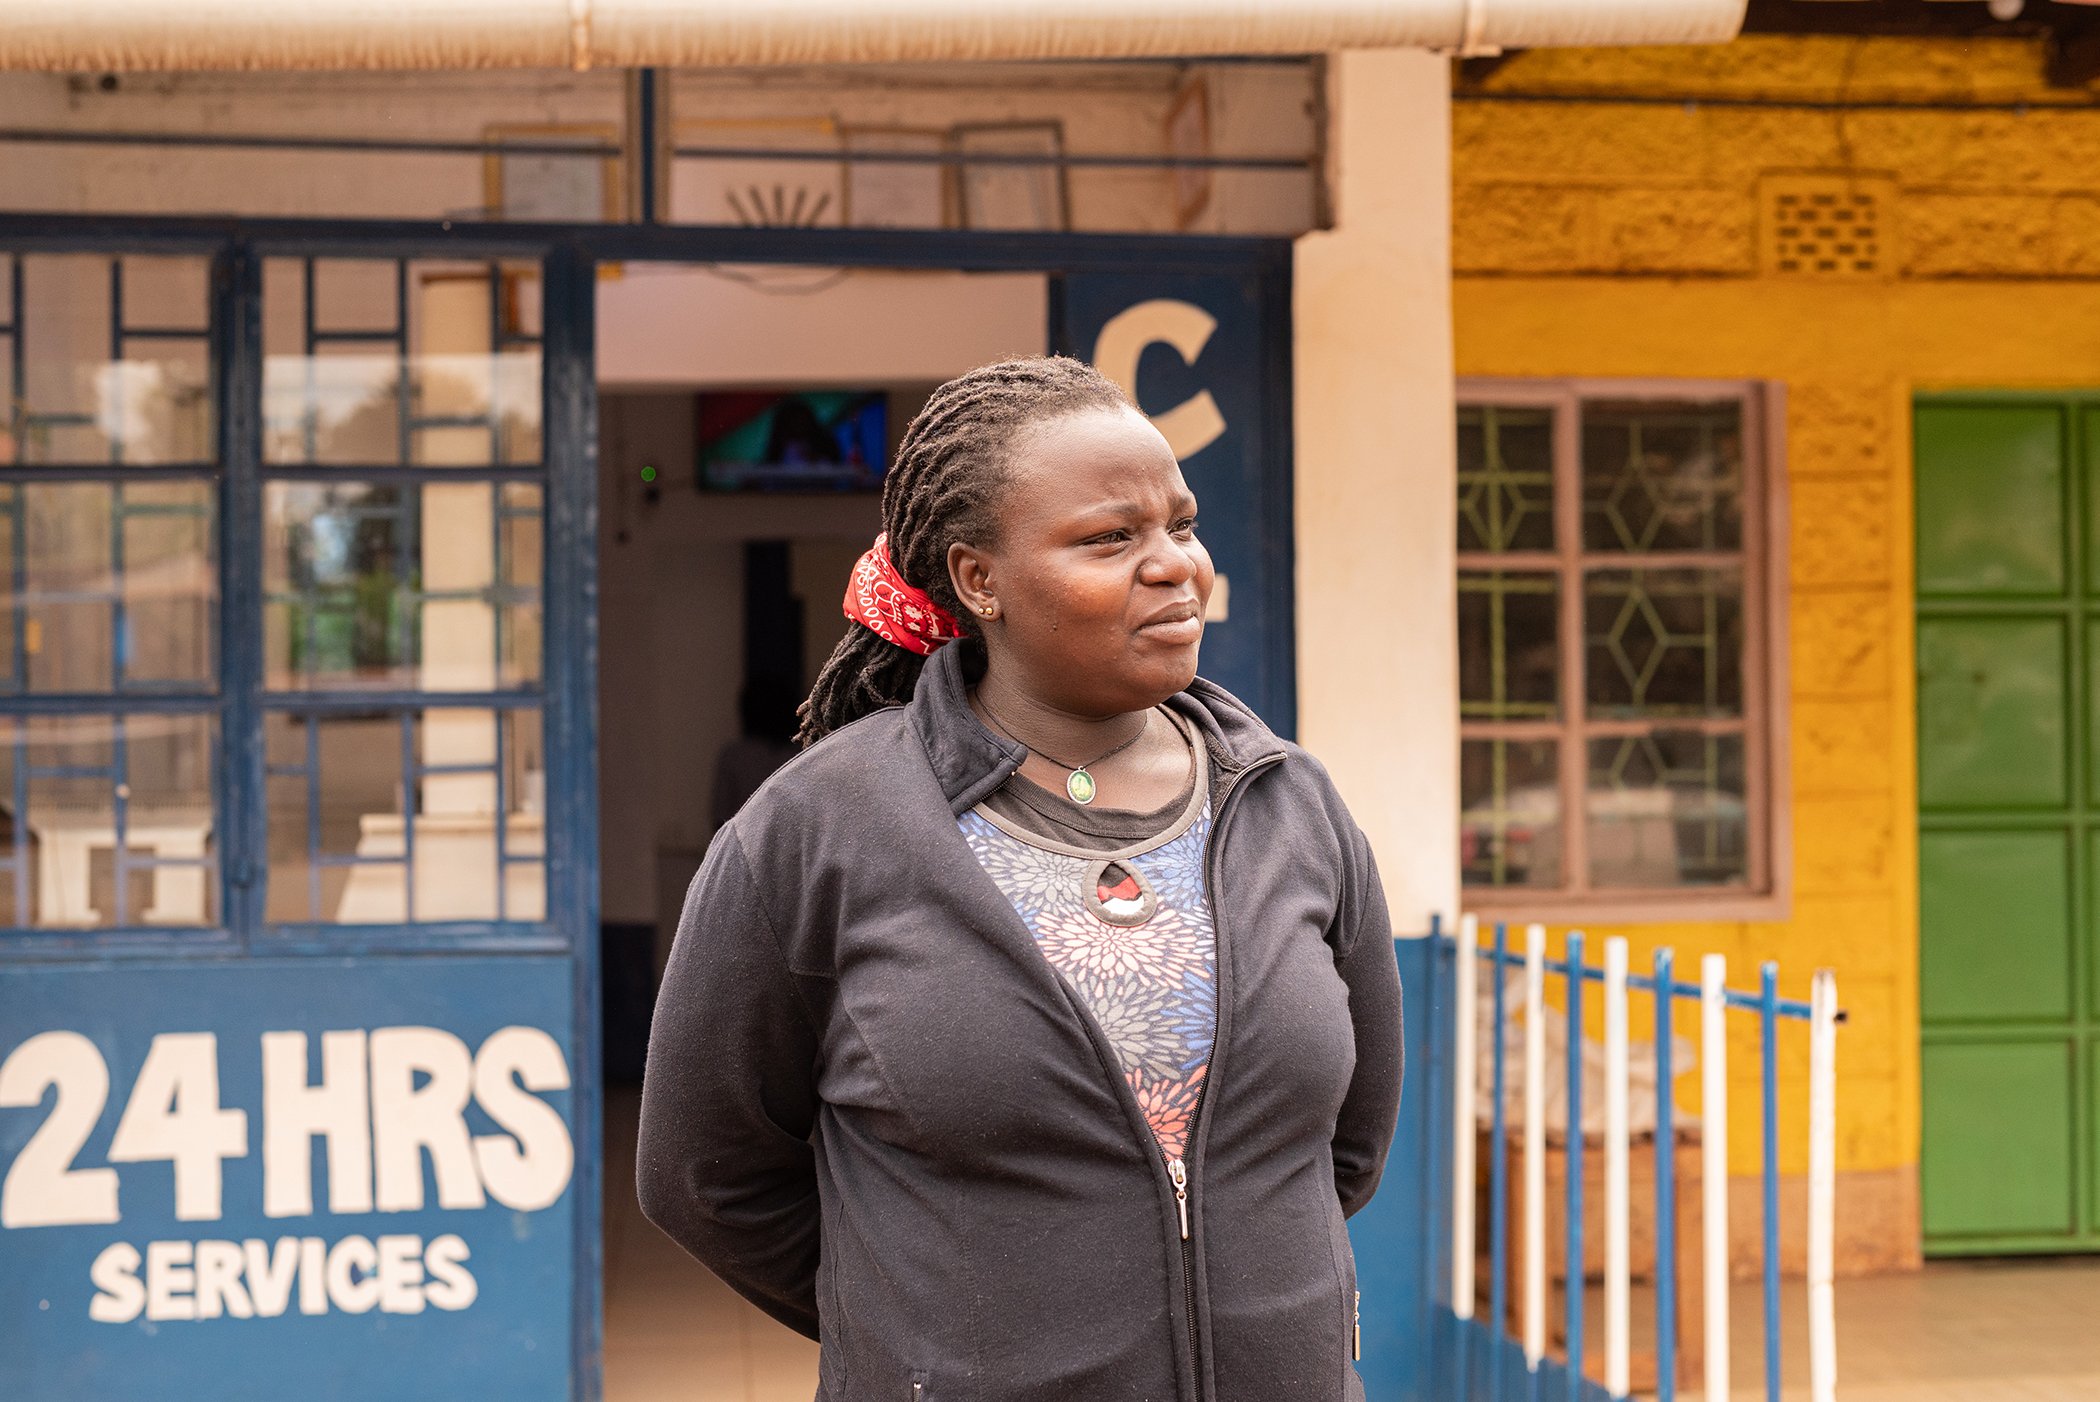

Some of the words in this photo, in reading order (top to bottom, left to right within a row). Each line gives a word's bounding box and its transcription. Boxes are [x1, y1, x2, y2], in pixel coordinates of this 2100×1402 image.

[1093, 298, 1227, 462] C
[0, 1029, 249, 1229] 24
[261, 1025, 575, 1218] HRS
[89, 1233, 478, 1324] SERVICES
